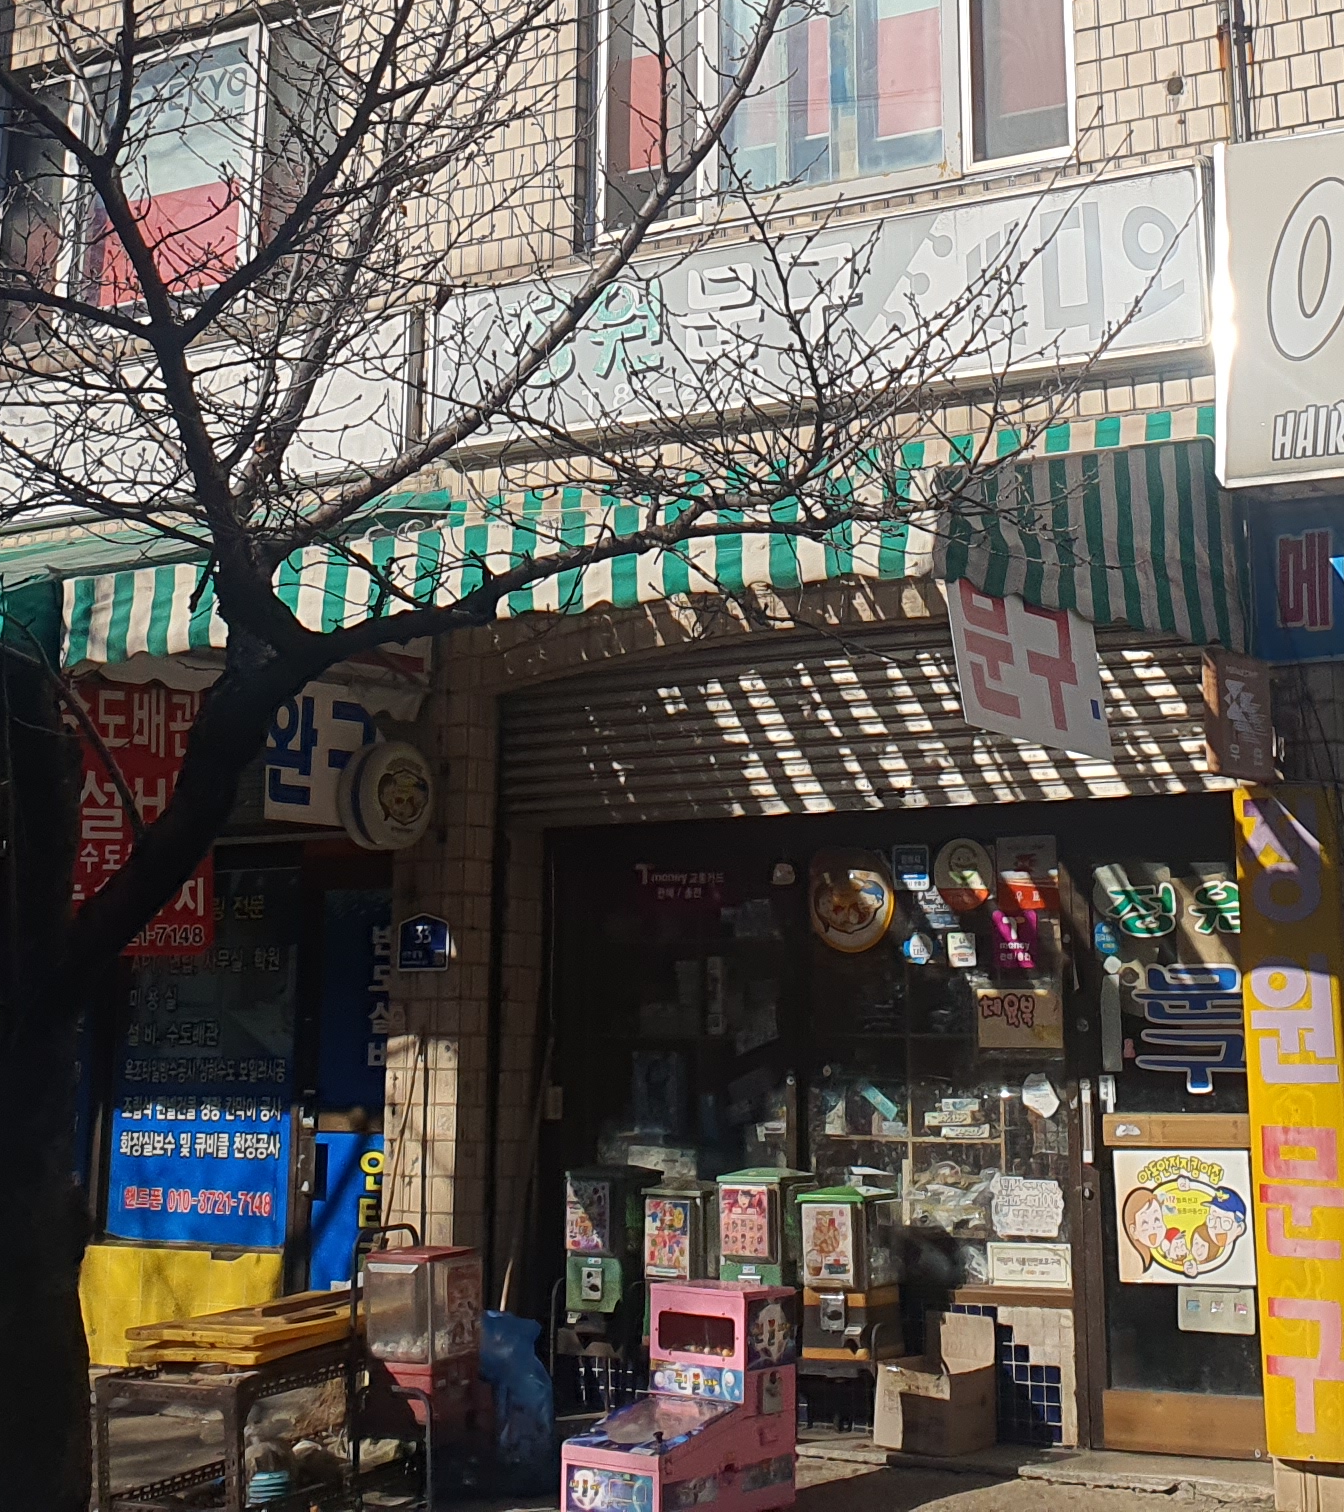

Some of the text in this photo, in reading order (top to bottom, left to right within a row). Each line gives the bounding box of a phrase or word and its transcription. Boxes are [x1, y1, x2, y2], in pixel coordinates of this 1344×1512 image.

[118, 1130, 282, 1161] 화장실보수 및 큐비클 천정공사
[166, 1187, 273, 1218] 010-3721-7148
